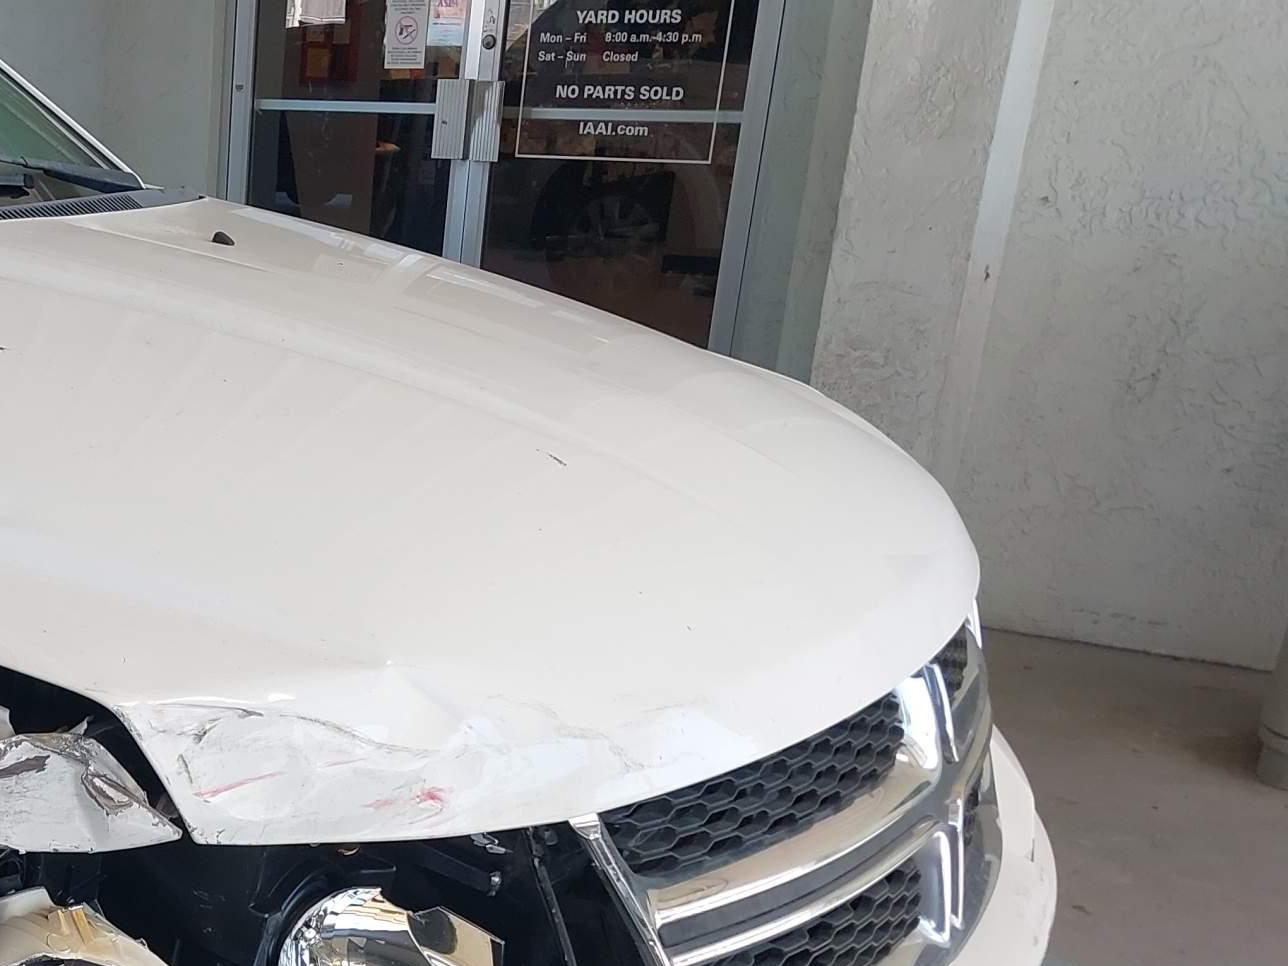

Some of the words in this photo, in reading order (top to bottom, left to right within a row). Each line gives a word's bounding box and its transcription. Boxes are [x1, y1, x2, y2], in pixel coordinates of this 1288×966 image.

[577, 10, 619, 24] YARD
[624, 9, 682, 24] HOURS
[540, 32, 562, 43] Mon
[574, 32, 587, 43] Fri
[605, 32, 628, 43] 8:00
[538, 51, 555, 62] Sat
[566, 51, 586, 62] Sun
[602, 51, 639, 62] Closed
[556, 85, 579, 99] NO
[583, 86, 635, 100] PARTS
[639, 86, 684, 101] SOLD
[579, 122, 648, 136] IAAI.com
